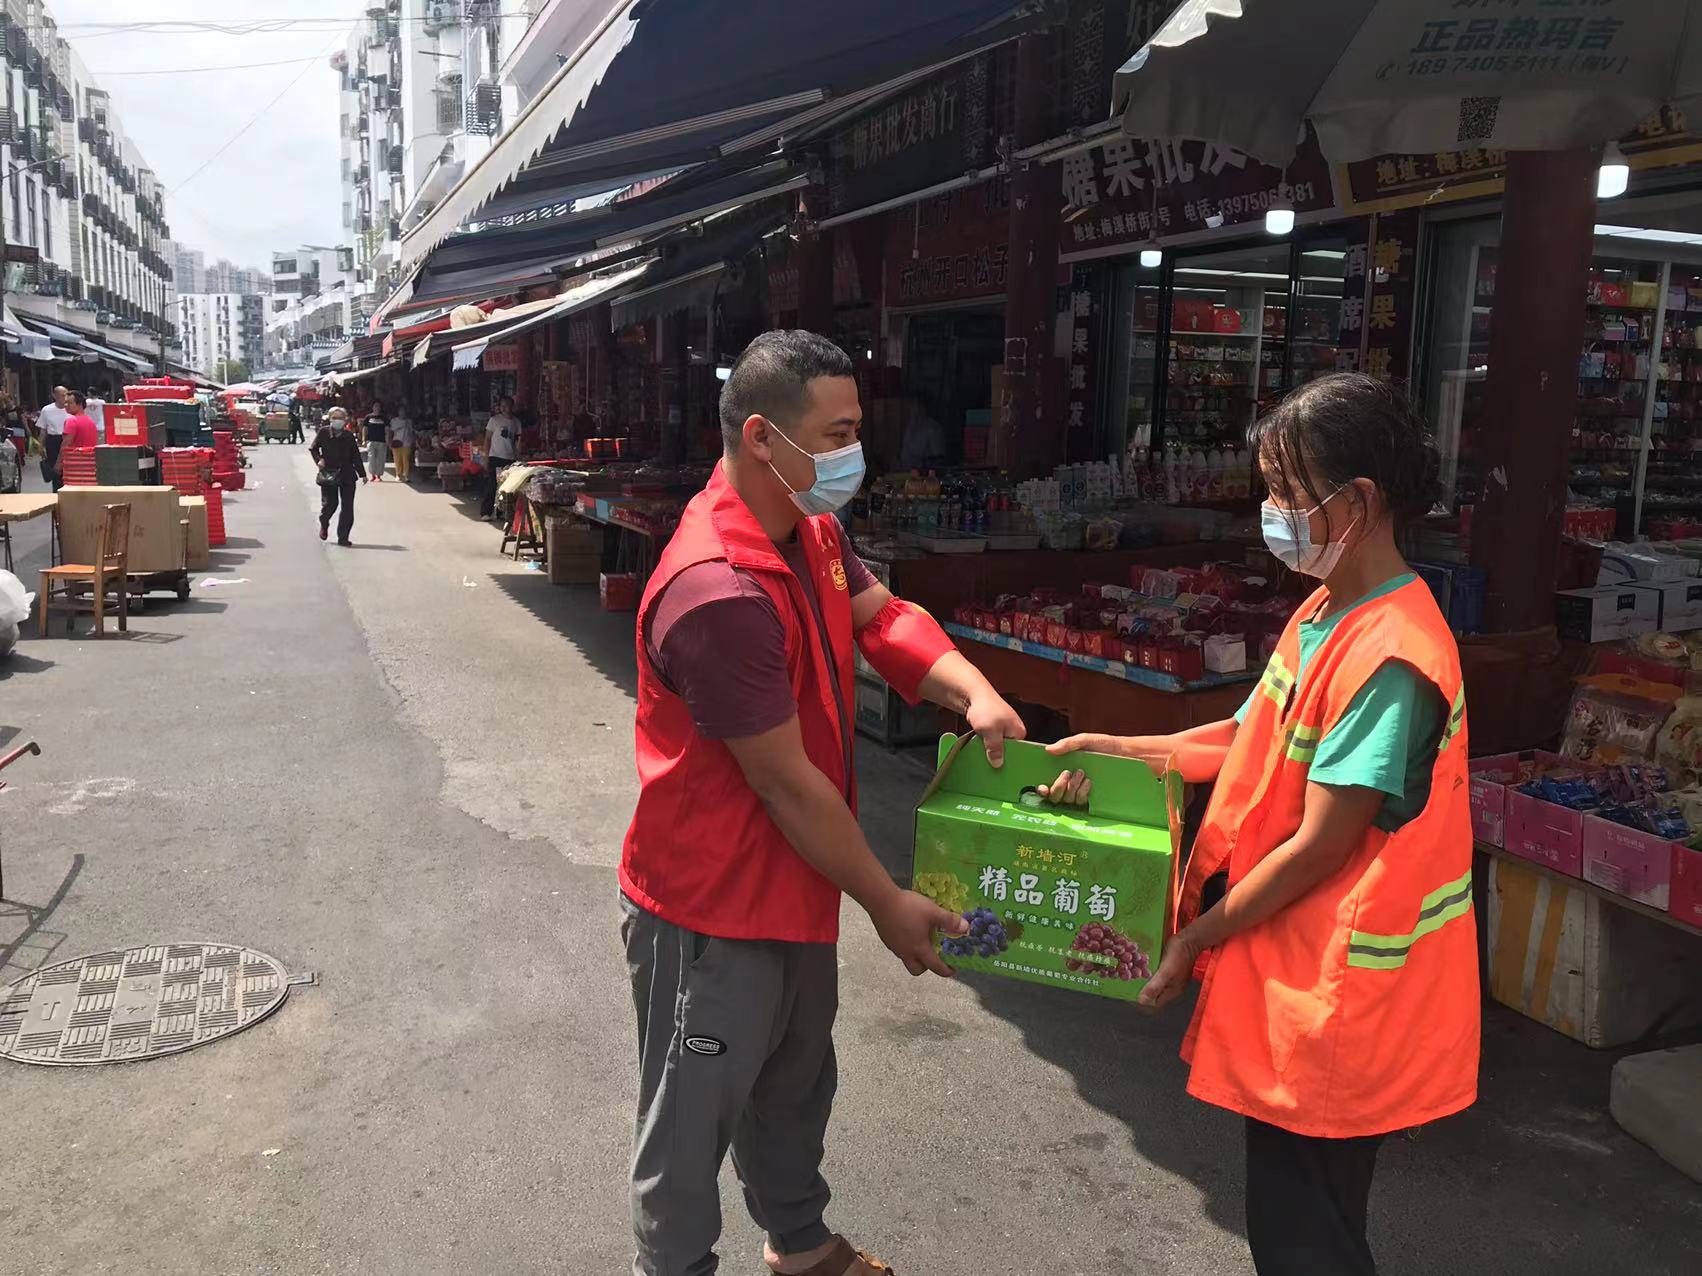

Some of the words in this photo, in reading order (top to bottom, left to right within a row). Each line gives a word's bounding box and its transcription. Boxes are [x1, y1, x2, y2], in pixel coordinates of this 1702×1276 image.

[1410, 16, 1625, 53] 正品热玛吉
[978, 864, 1118, 921] 精品葡萄
